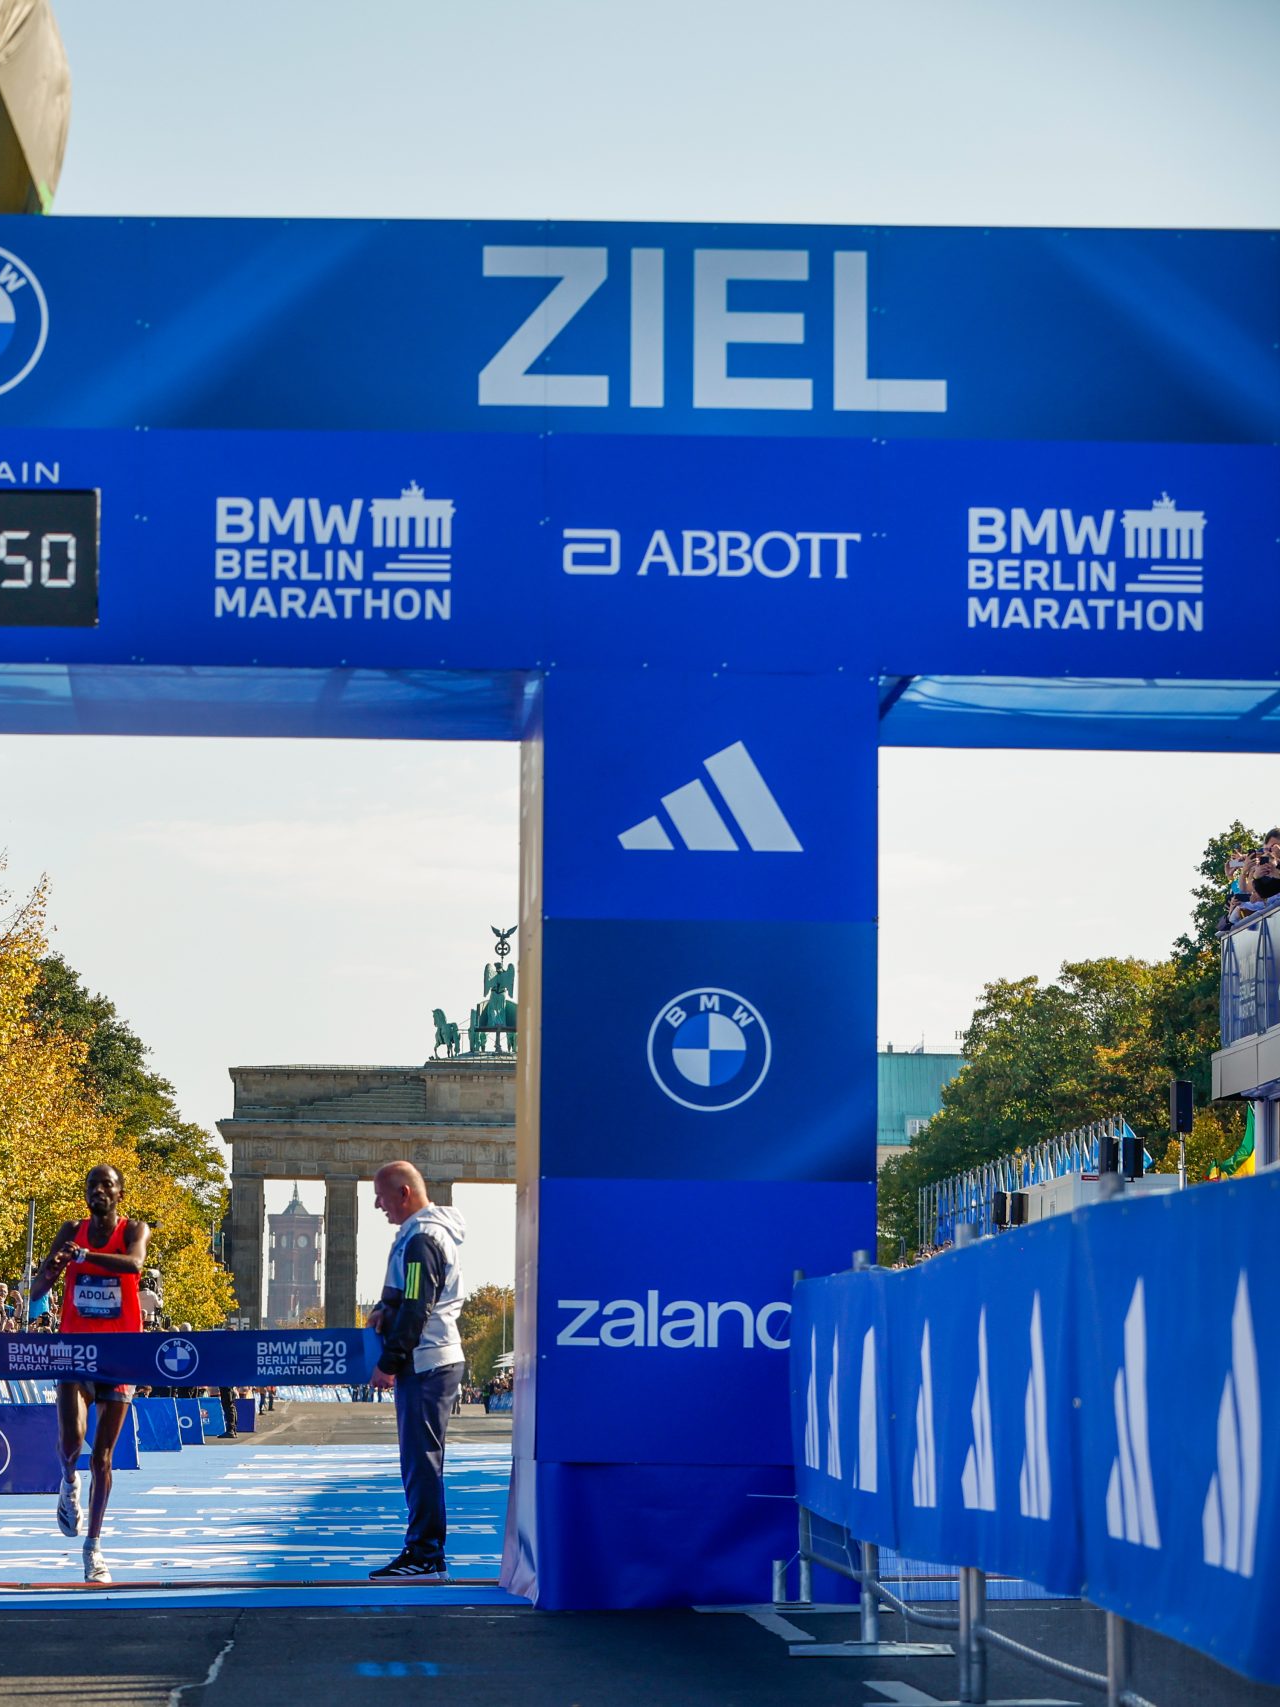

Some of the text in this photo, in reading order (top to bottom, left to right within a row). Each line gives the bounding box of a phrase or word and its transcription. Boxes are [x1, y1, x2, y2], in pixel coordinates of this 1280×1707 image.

[479, 246, 947, 412] ZIEL
[216, 497, 363, 545] BMW
[968, 508, 1115, 555] BMW
[637, 530, 861, 579] ABBOTT
[216, 549, 364, 581] BERLIN
[968, 560, 1116, 592] BERLIN
[215, 587, 451, 620] MARATHON
[968, 597, 1203, 631] MARATHON
[665, 994, 755, 1029] BMW
[78, 1290, 116, 1300] ADOLA
[8, 1343, 48, 1356] BMW
[73, 1344, 98, 1360] 20
[161, 1340, 193, 1353] BMW
[257, 1342, 297, 1355] BMW
[323, 1341, 347, 1357] 20
[8, 1355, 49, 1364] BERLIN
[9, 1363, 73, 1371] MARATHON
[74, 1361, 98, 1372] 26
[257, 1356, 298, 1365] BERLIN
[323, 1359, 347, 1375] 26
[257, 1366, 321, 1376] MARATHON
